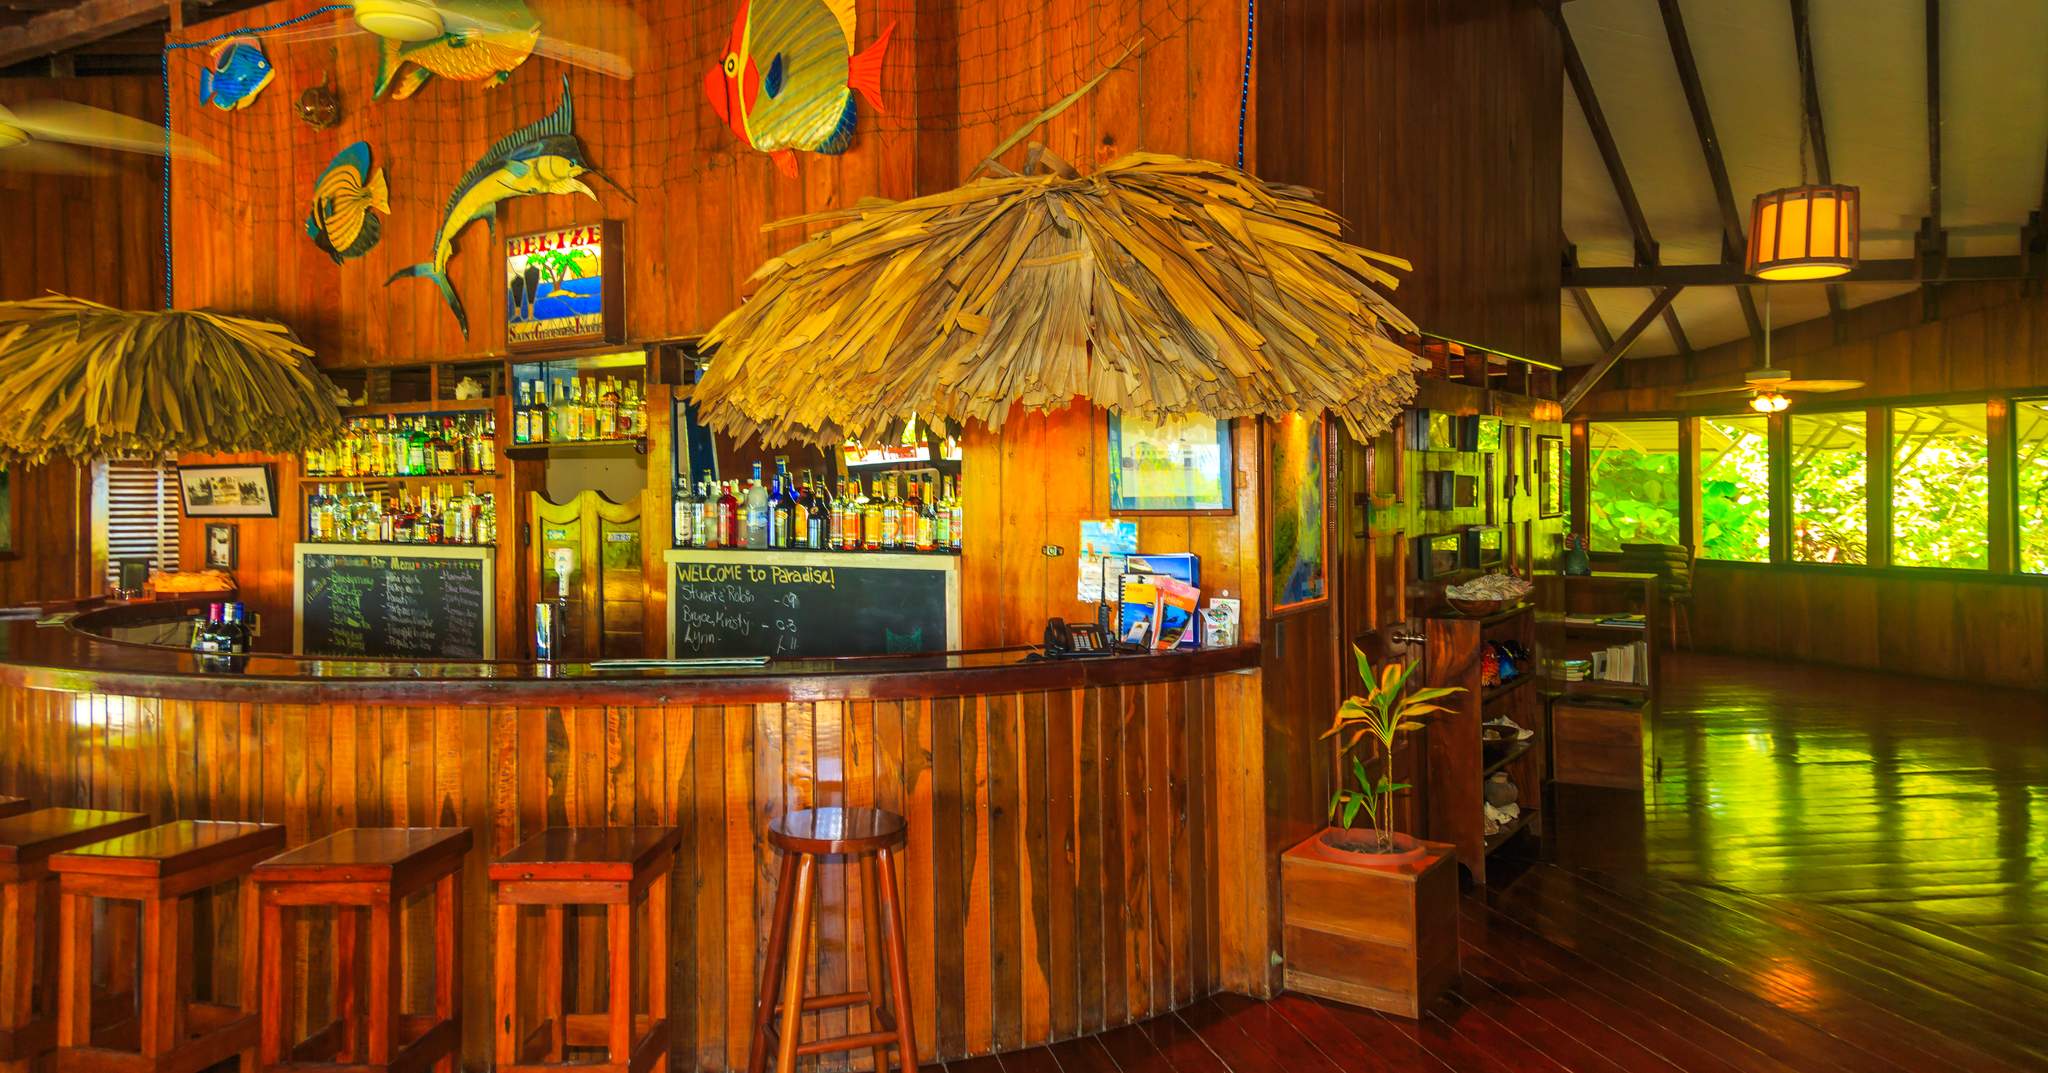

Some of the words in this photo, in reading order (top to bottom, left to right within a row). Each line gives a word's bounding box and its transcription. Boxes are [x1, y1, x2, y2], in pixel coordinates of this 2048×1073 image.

[508, 226, 601, 257] BELIZE
[677, 565, 741, 582] WELCOME
[748, 568, 767, 582] to
[771, 566, 836, 589] Paradise!
